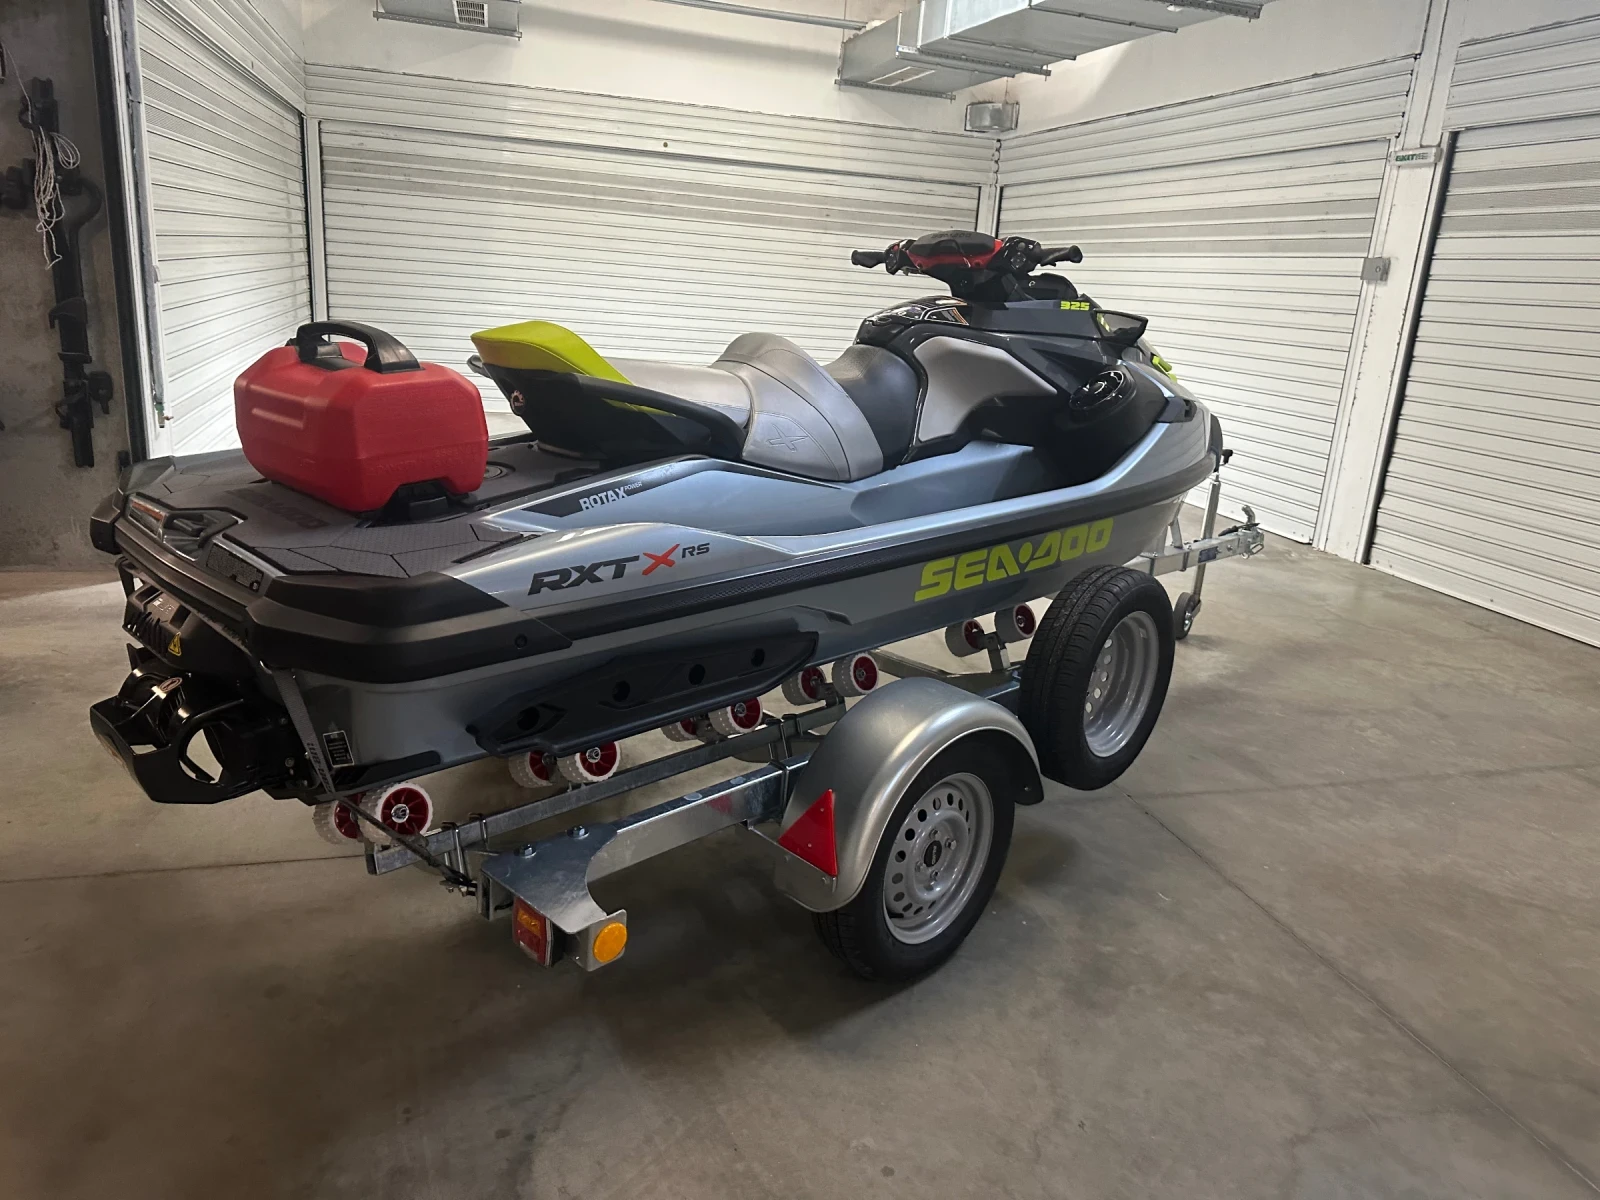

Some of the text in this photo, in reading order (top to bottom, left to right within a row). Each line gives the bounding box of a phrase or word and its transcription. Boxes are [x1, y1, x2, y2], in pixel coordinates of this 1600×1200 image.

[1060, 300, 1090, 311] 325
[579, 481, 643, 511] ROTAX POWER
[527, 542, 710, 596] RXT X RS
